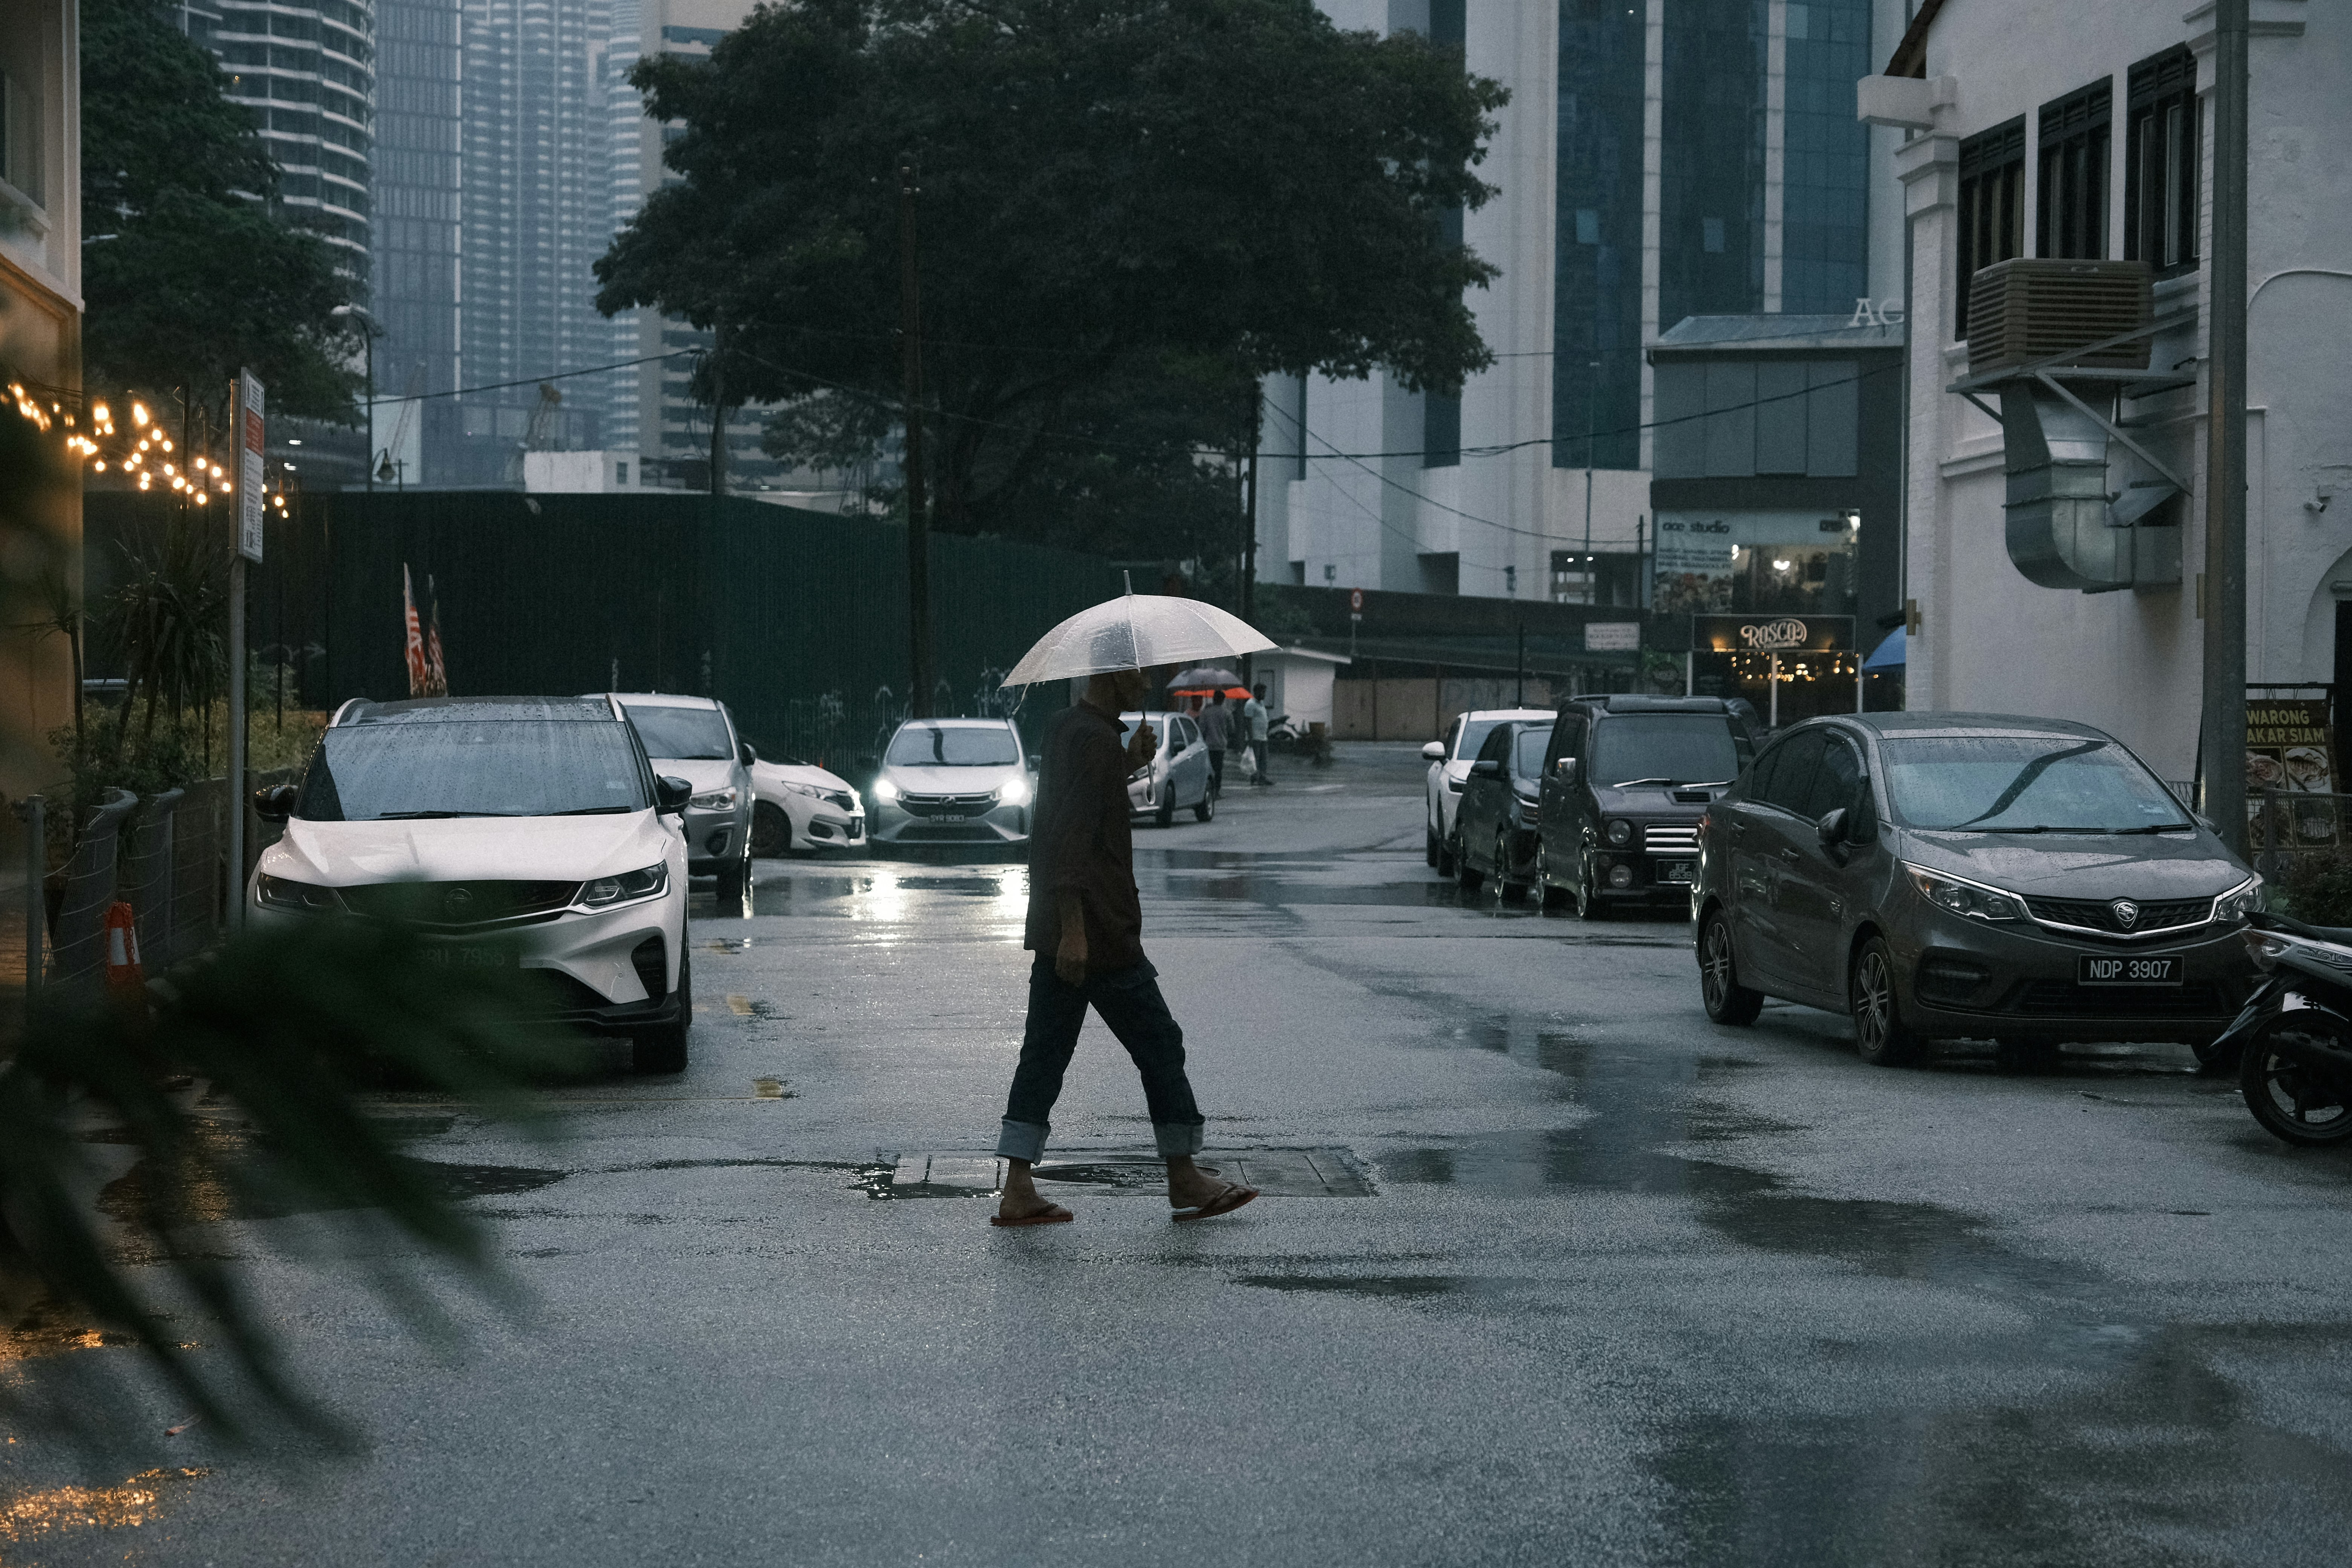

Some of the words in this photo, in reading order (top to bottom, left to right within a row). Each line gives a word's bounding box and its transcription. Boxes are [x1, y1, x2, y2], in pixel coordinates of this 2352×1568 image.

[1690, 519, 1730, 534] studio
[1741, 619, 1807, 648] ROSCO
[2246, 709, 2310, 725] WARONG
[2290, 727, 2325, 743] SIAM
[2090, 960, 2123, 978] NDP
[2129, 960, 2172, 978] 3907
